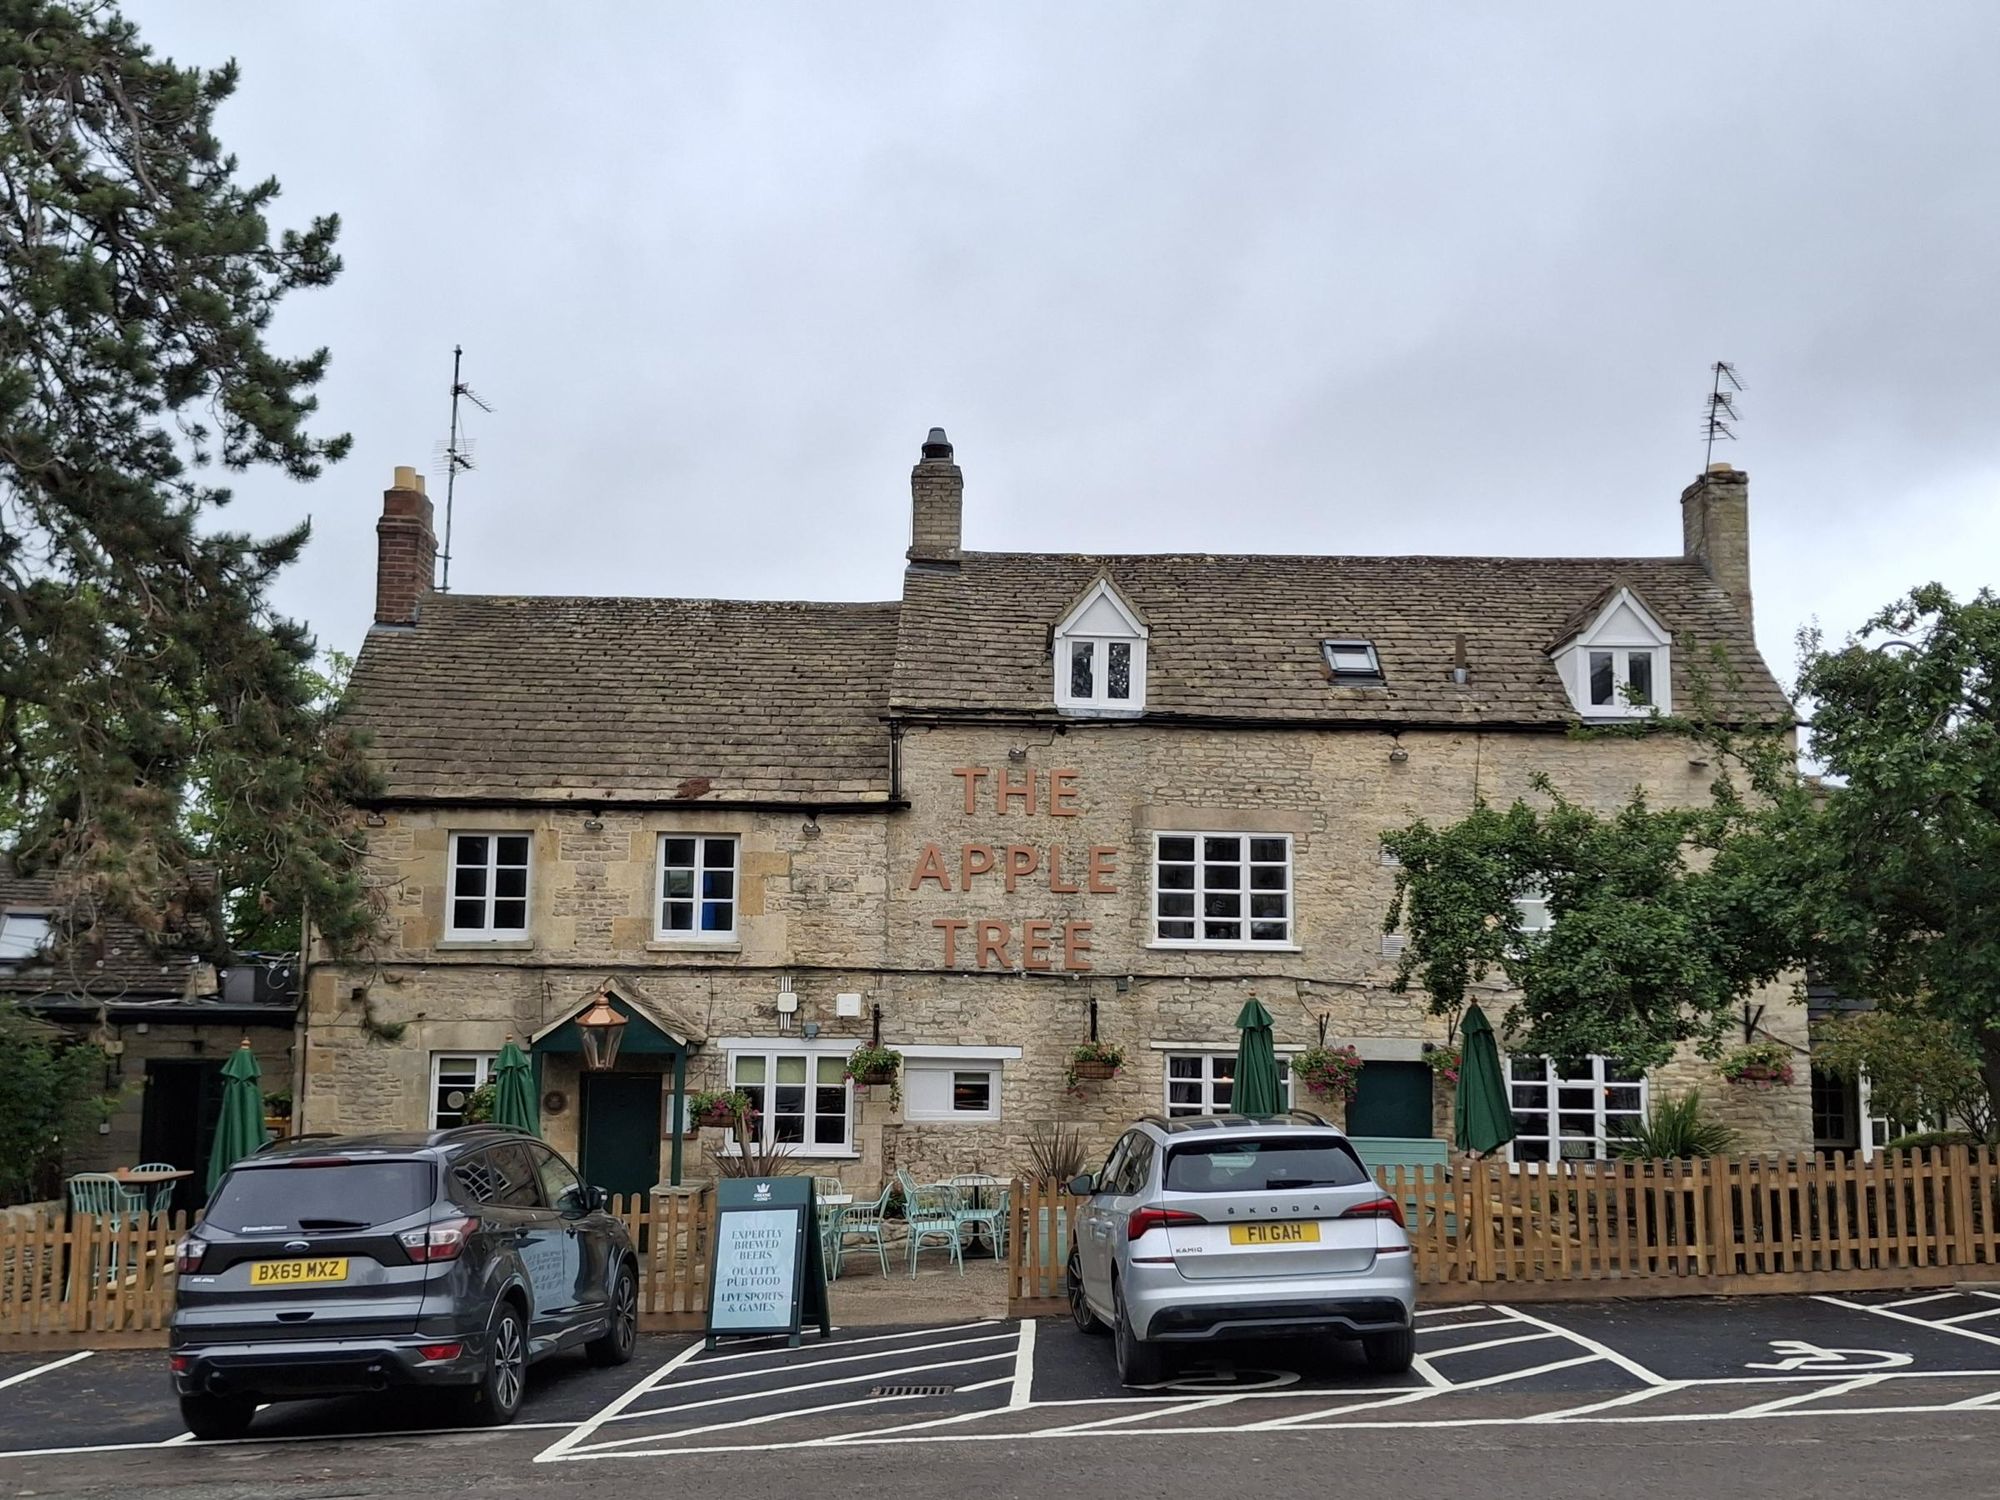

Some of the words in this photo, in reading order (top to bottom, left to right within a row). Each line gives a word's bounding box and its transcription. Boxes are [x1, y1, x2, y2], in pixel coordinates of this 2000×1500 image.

[953, 767, 1079, 816] THE
[909, 842, 1117, 893] APPLE
[932, 919, 1093, 970] TREE
[732, 1230, 783, 1239] EXPERTLY
[1270, 1224, 1302, 1241] GAH
[734, 1240, 779, 1250] BREWED
[739, 1251, 773, 1260] BEERS
[258, 1263, 302, 1281] BX69
[306, 1260, 340, 1278] MXZ
[732, 1266, 776, 1275] QUALITY
[727, 1277, 749, 1287] PUB
[750, 1276, 781, 1286] FOOD
[721, 1292, 743, 1302] LIVE
[744, 1290, 784, 1301] SPORTS
[727, 1305, 736, 1313] &
[738, 1302, 776, 1313] GAMES
